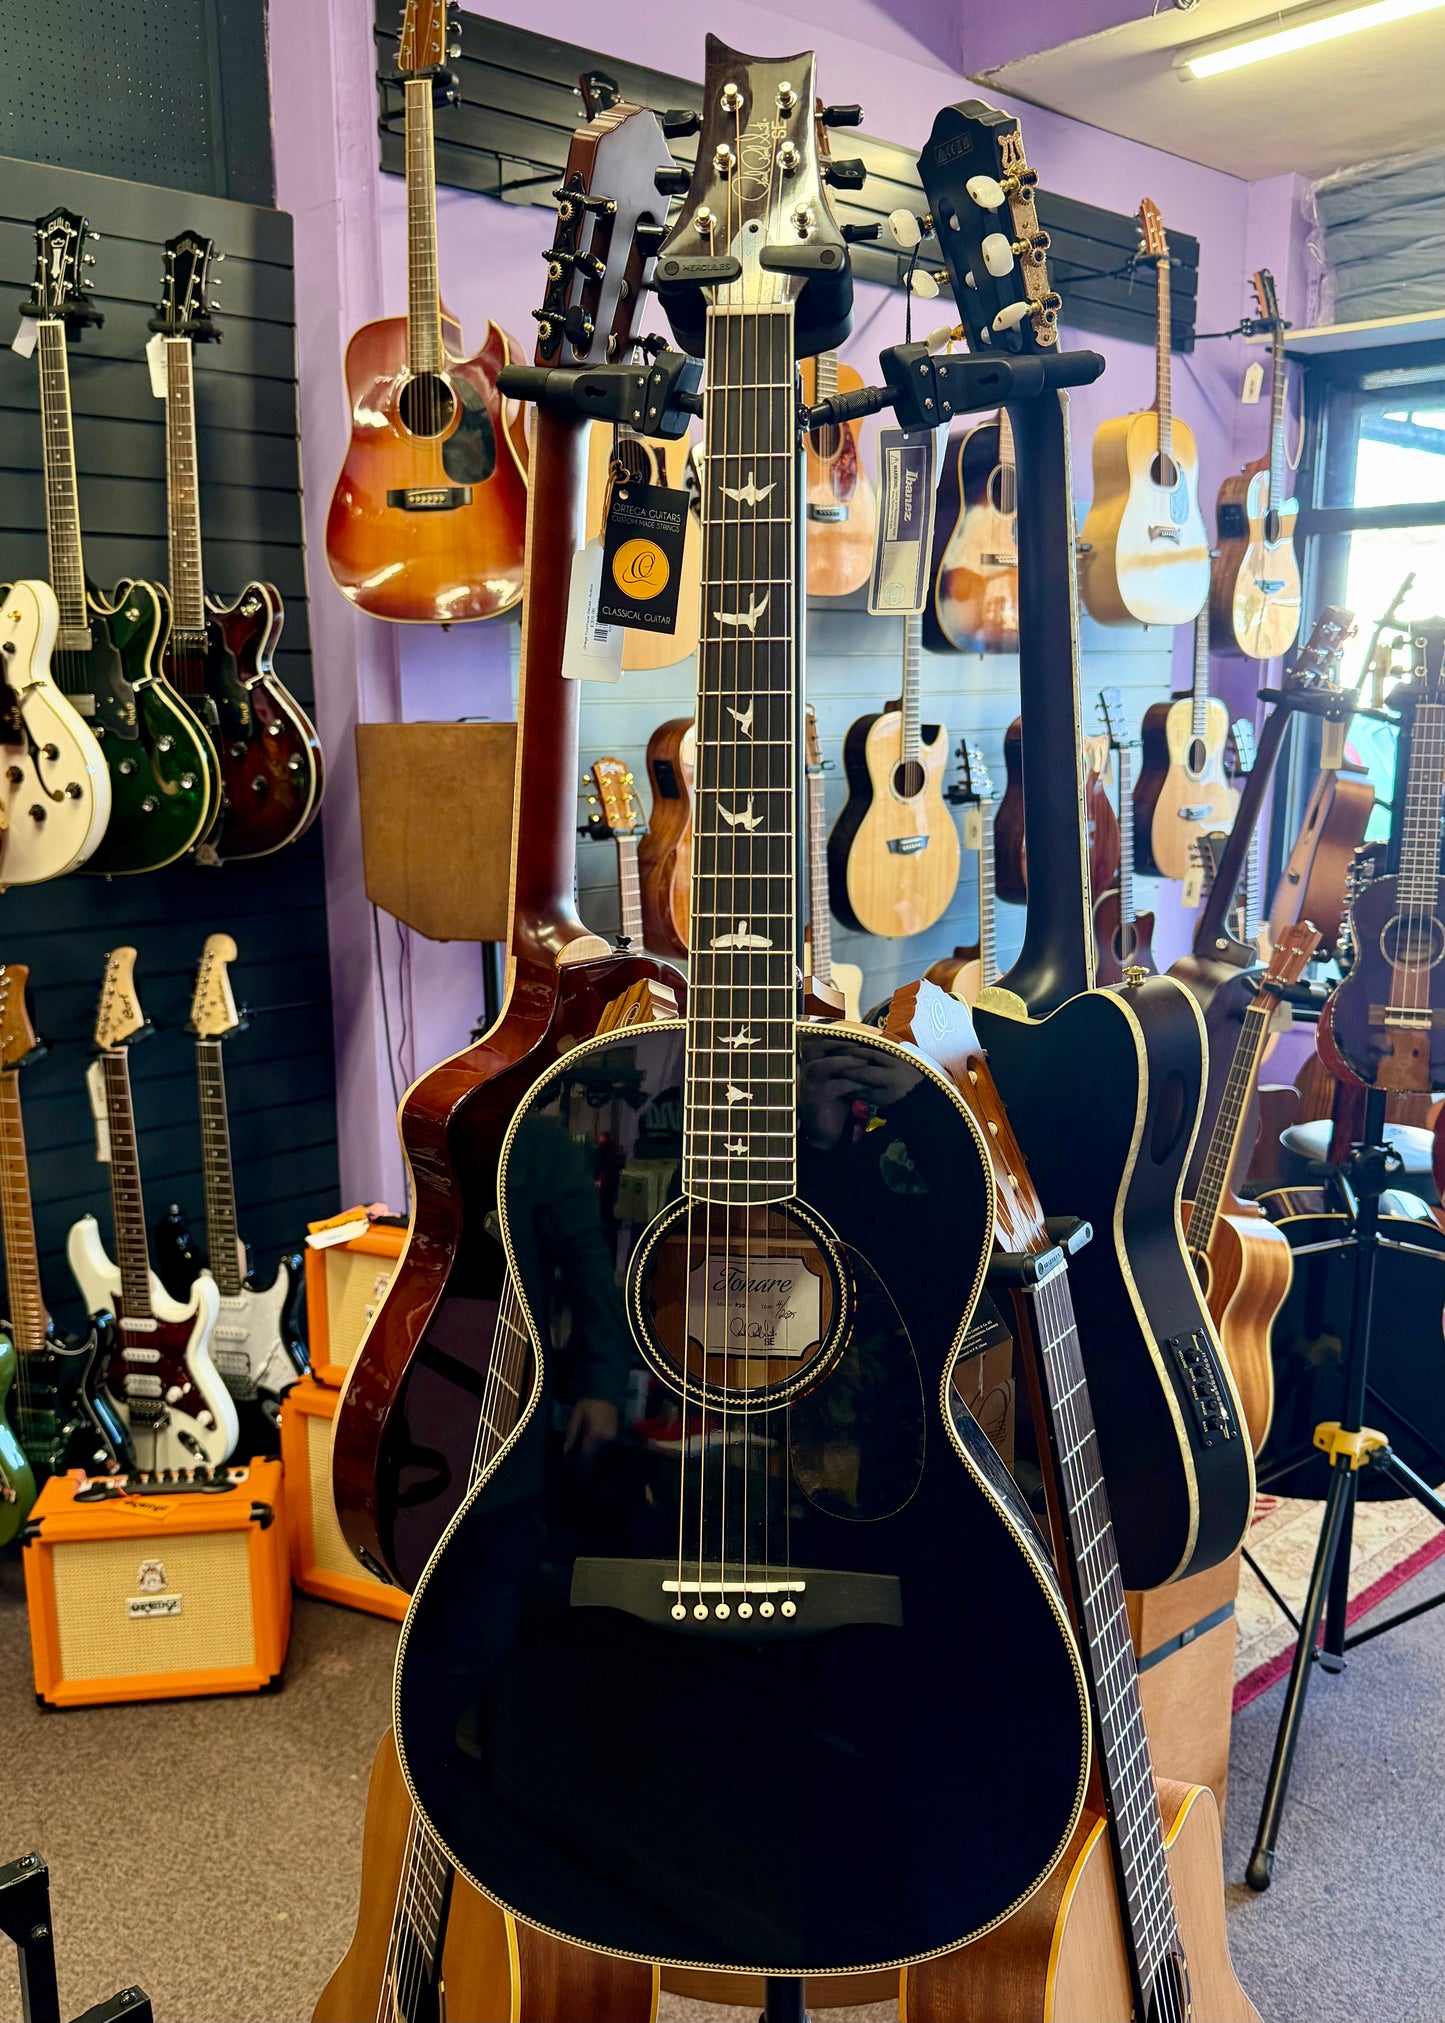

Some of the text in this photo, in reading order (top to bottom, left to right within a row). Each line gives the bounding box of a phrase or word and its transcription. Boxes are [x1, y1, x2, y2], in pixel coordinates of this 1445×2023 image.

[771, 120, 787, 139] SE
[682, 263, 732, 272] HERCULES
[903, 468, 919, 522] Ibanez
[612, 502, 681, 523] ORTEGA GUITARS
[611, 514, 680, 533] CUSTOM MADE STRINGS
[602, 605, 672, 625] CLASSICAL GUITAR
[127, 702, 136, 726] GUILD
[240, 701, 249, 725] GUILD
[712, 1266, 793, 1293] Tonare
[1178, 1350, 1188, 1369] VOLUME
